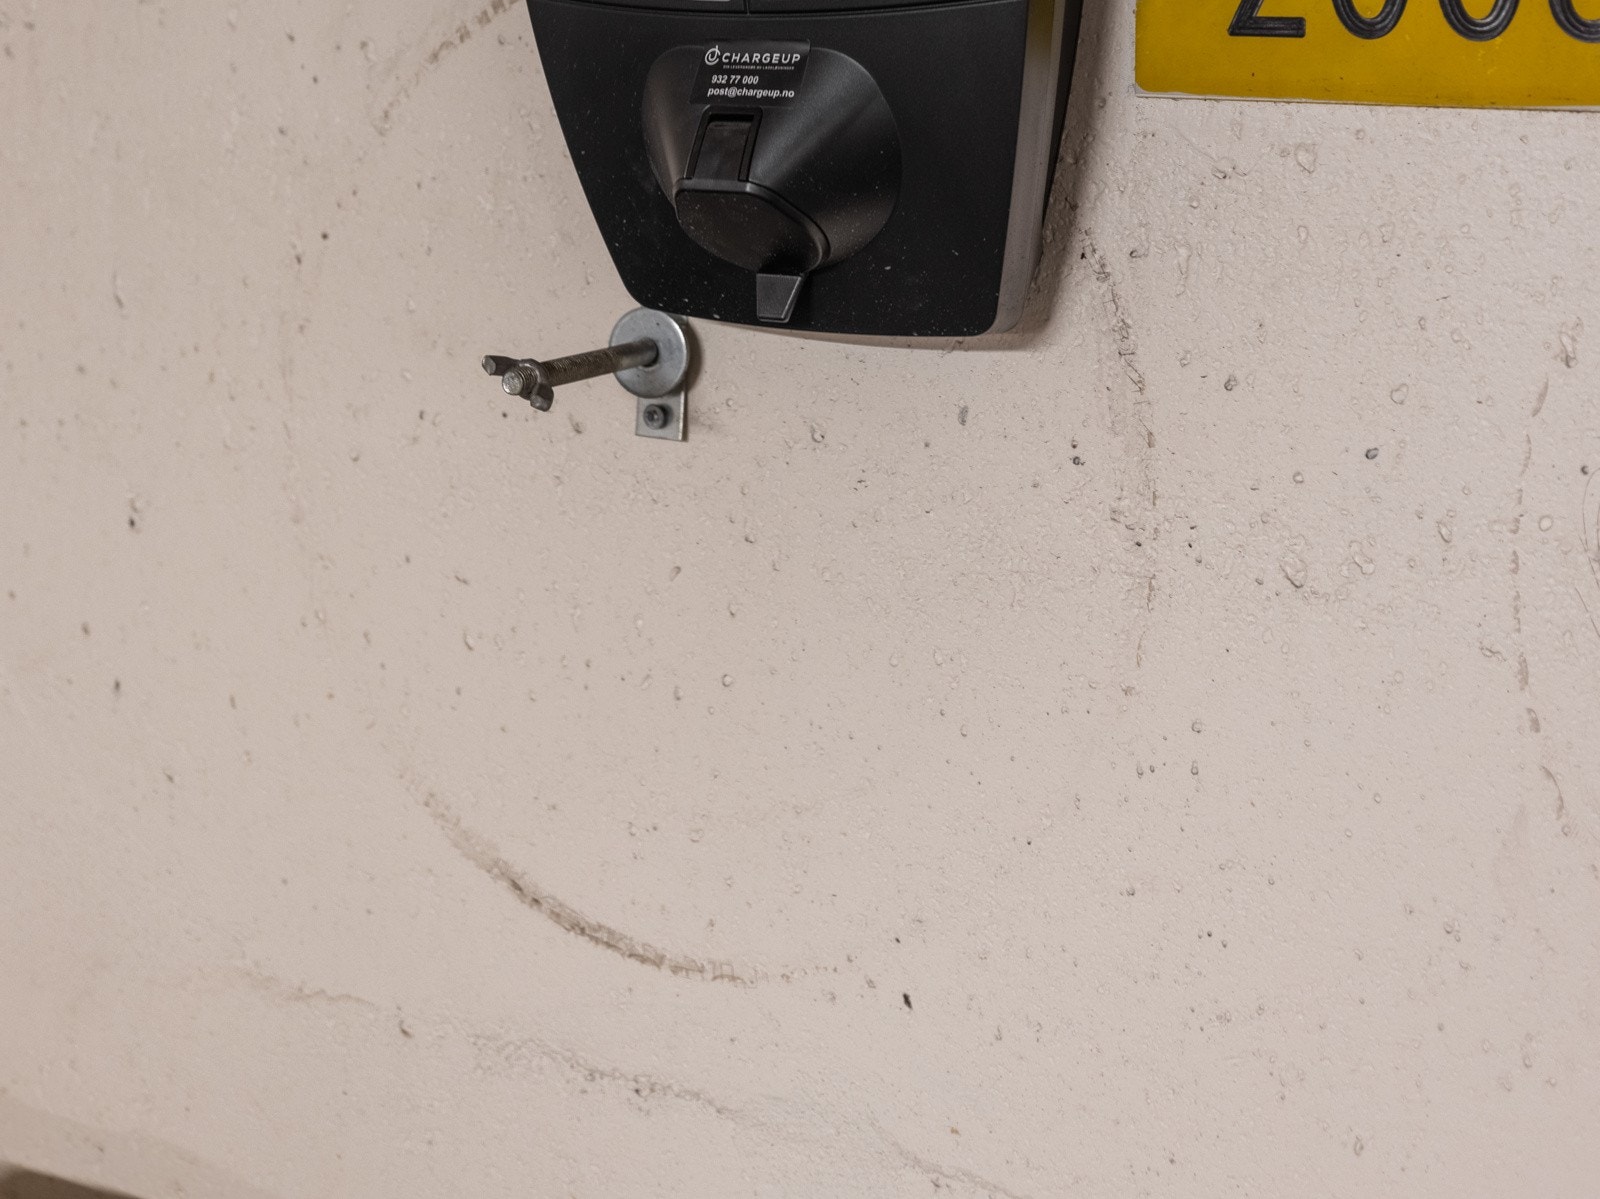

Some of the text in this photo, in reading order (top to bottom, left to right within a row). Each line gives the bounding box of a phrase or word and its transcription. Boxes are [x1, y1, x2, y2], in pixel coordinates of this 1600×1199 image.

[721, 52, 801, 65] CHARGEUP
[711, 74, 759, 84] 932 77 000
[707, 86, 795, 99] post@chargeup.no
